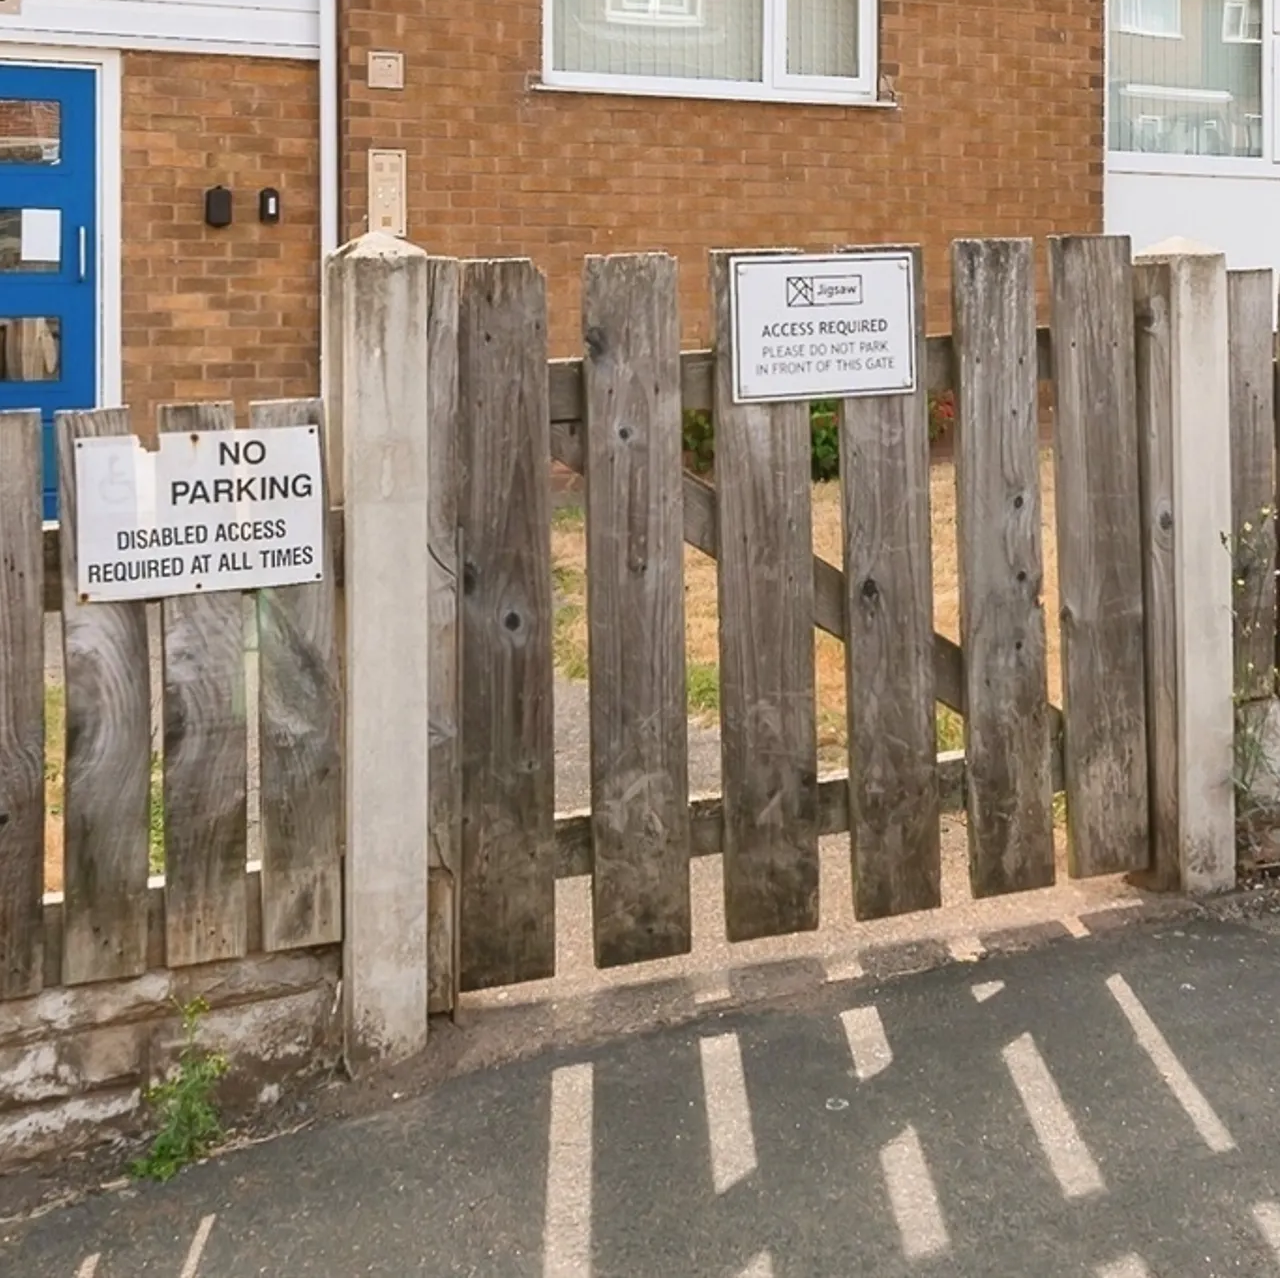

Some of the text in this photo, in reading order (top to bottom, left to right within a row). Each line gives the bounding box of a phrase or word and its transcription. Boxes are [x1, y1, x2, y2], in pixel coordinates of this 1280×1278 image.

[816, 283, 858, 298] Jigsaw
[761, 318, 889, 338] ACCESS REQUIRED
[762, 339, 889, 358] PLEASE DO NOT PARK
[755, 356, 896, 376] IN FRONT OF THIS GATE
[219, 440, 266, 466] NO
[171, 473, 313, 506] PARKING
[117, 519, 287, 550] DISABLED ACCESS
[88, 545, 314, 583] REQUIRED AT ALL TIMES
